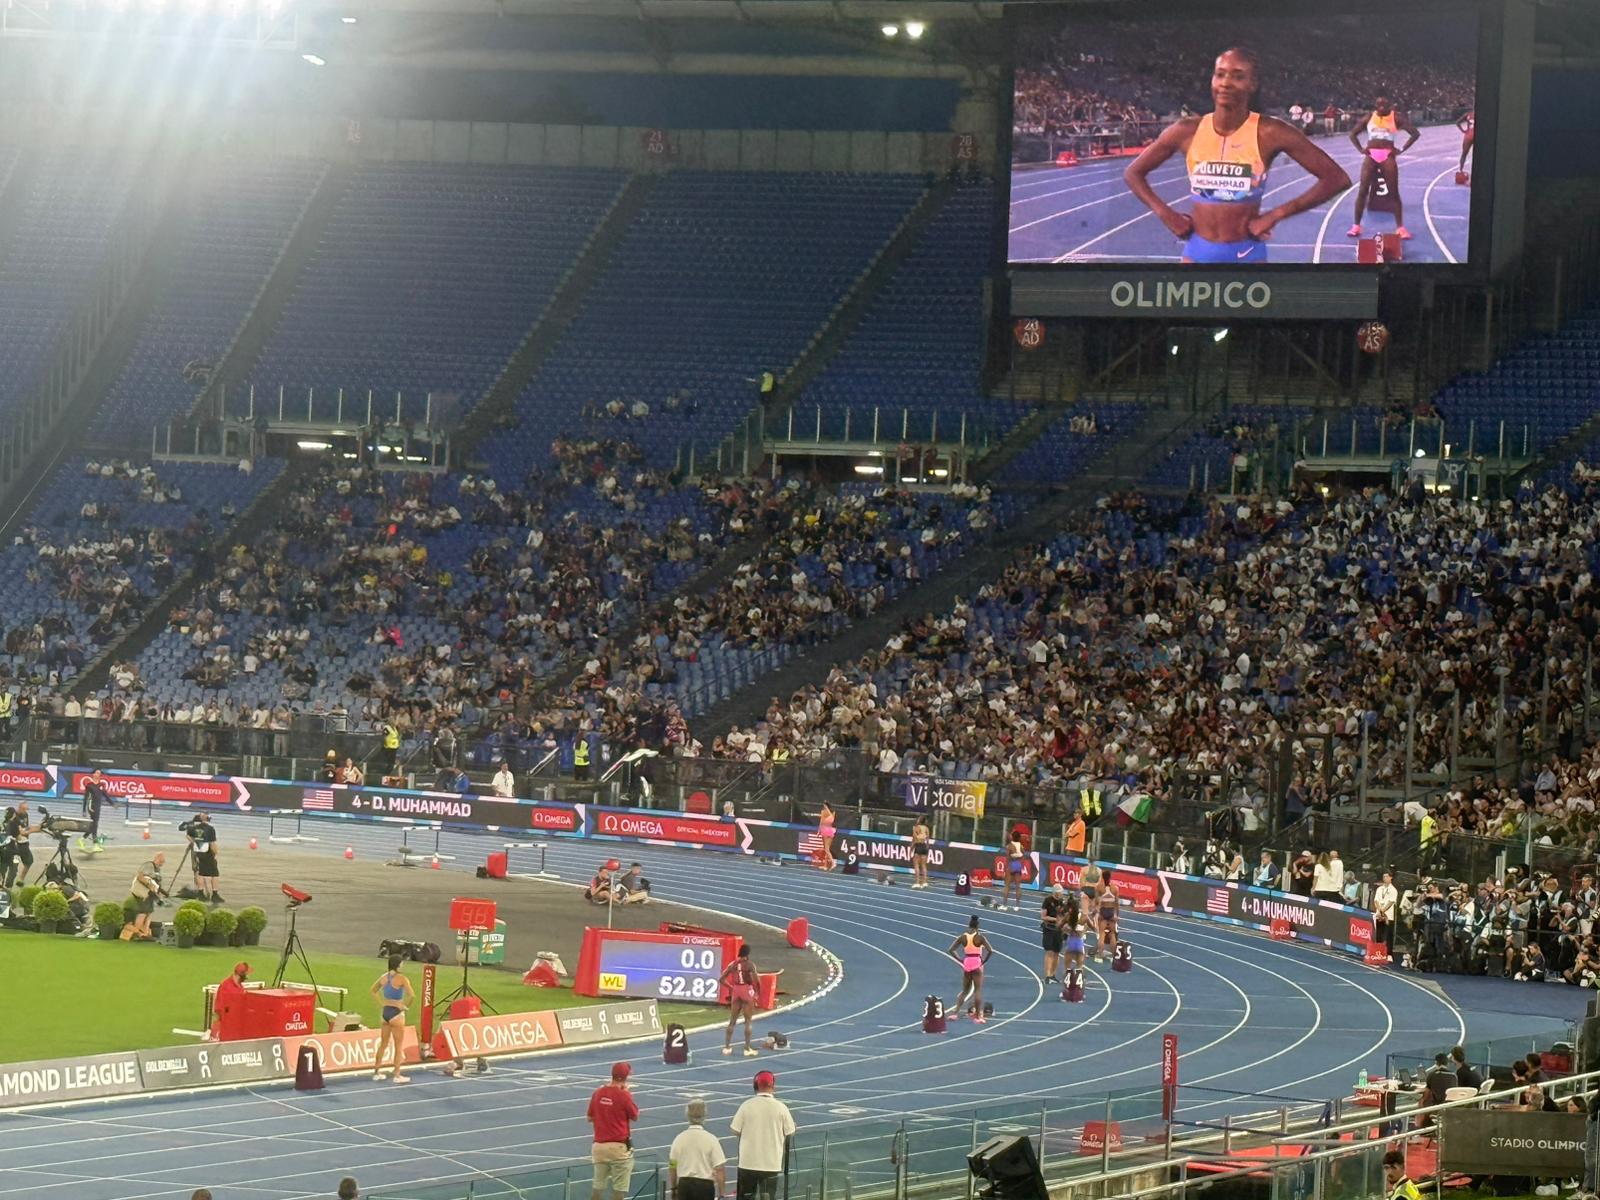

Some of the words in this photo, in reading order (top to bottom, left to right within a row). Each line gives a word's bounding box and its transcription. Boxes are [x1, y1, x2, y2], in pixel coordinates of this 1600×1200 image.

[1376, 178, 1389, 196] 3
[1110, 281, 1271, 308] OLIMPICO
[12, 776, 42, 786] OMEGA
[388, 797, 472, 818] MUHAMMAD
[544, 814, 573, 826] OMEGA
[620, 819, 664, 835] OMEGA
[848, 853, 857, 865] 9
[872, 842, 944, 865] MUHAAD
[958, 873, 967, 886] 8
[1262, 900, 1315, 928] MUHAMMAD
[681, 948, 714, 969] 0.0
[1114, 945, 1123, 960] 5
[603, 975, 624, 989] WL
[658, 975, 718, 999] 52.82
[1075, 972, 1084, 989] 4
[934, 1001, 943, 1019] 3
[483, 1020, 549, 1049] OMEGA
[671, 1028, 684, 1048] 2
[304, 1052, 313, 1073] 1
[64, 1060, 137, 1090] LEAGUE
[1490, 1137, 1535, 1149] STADIO
[1537, 1139, 1587, 1151] OLIMPIC
